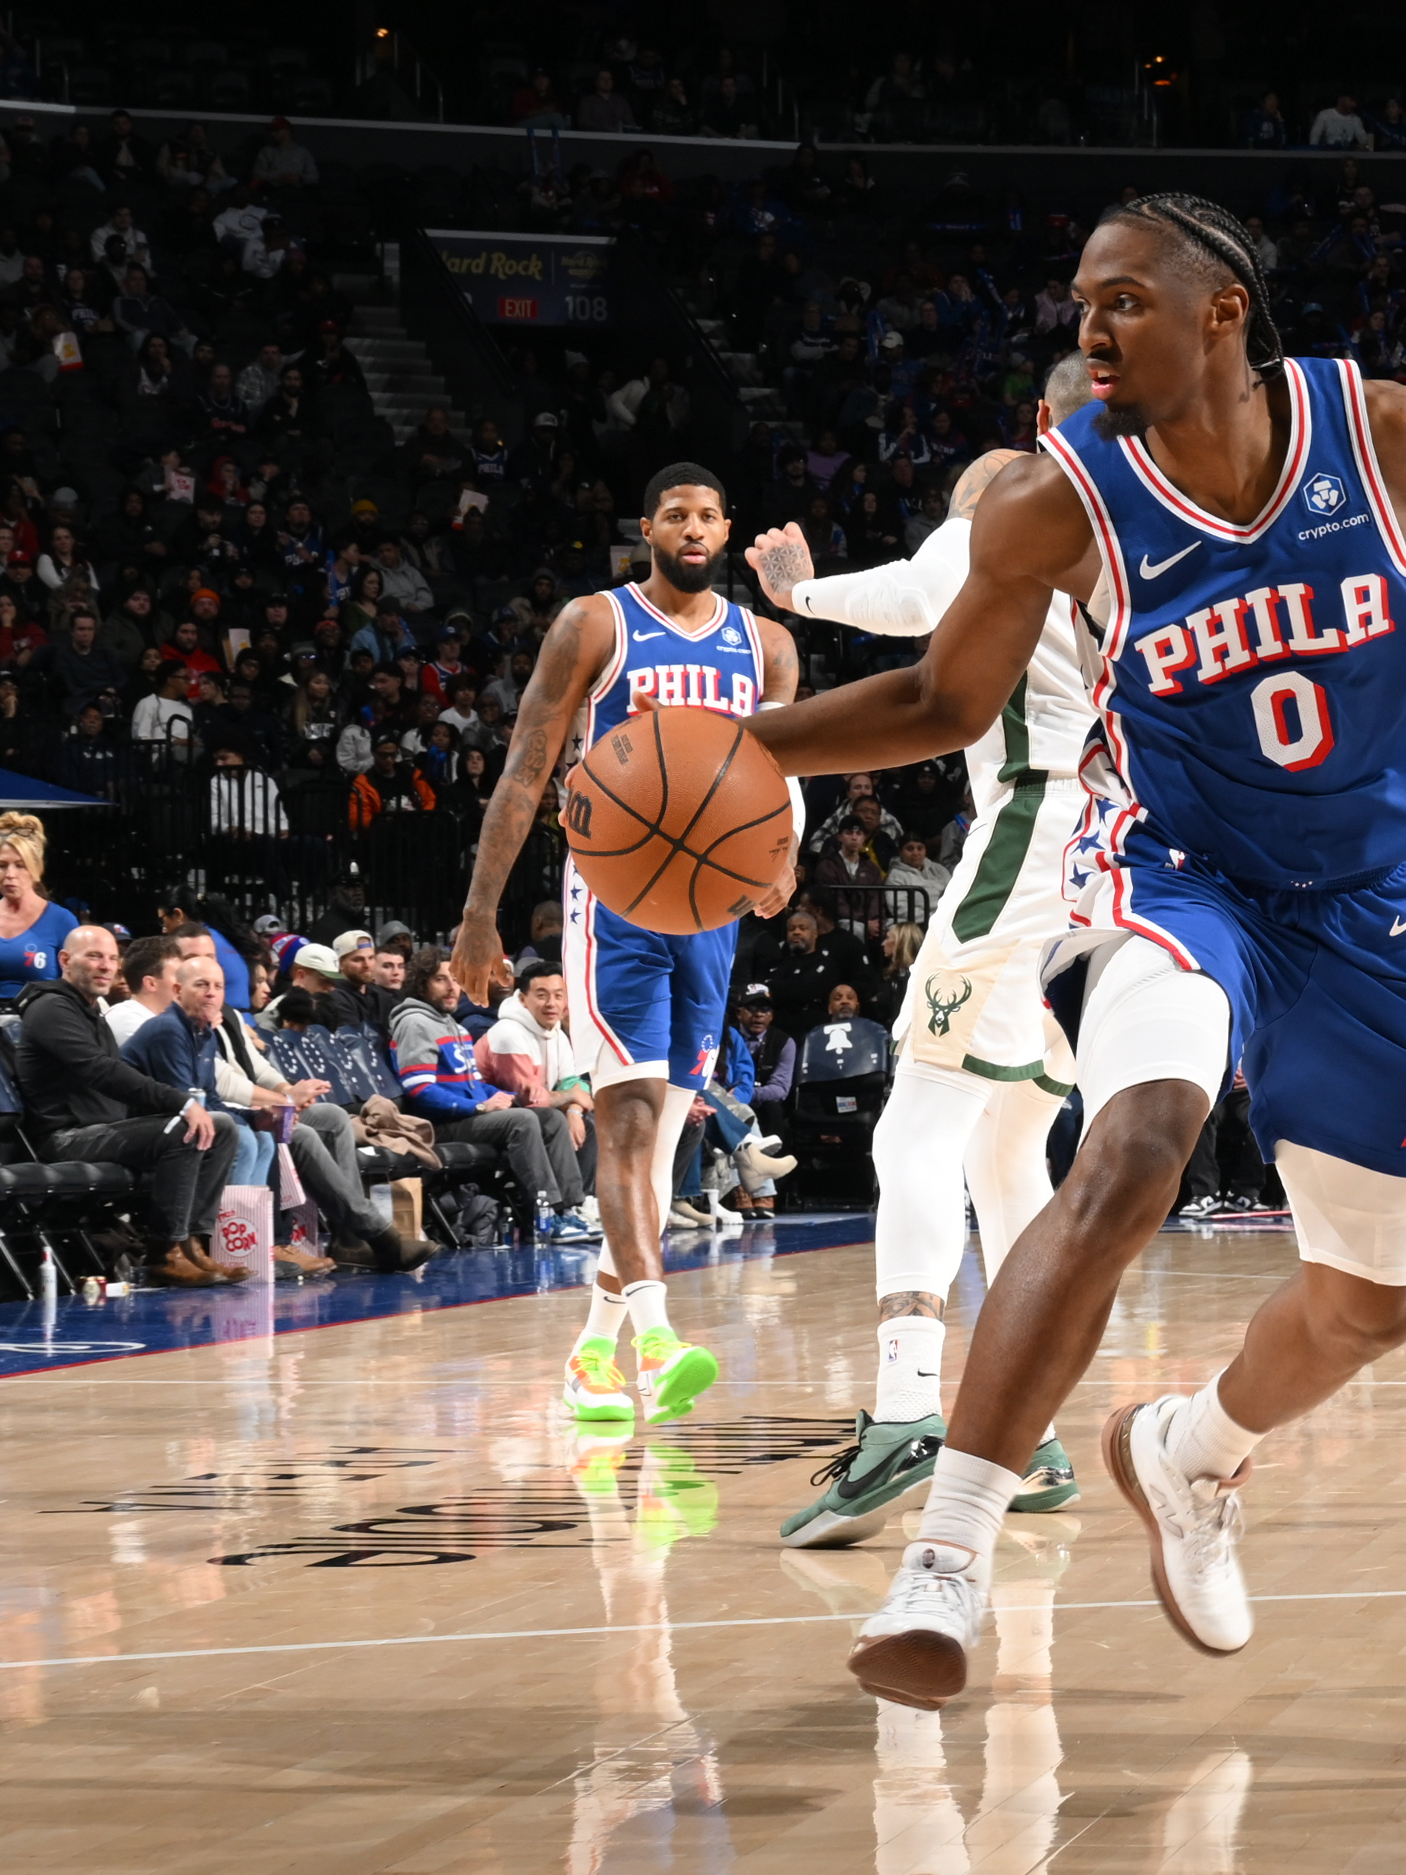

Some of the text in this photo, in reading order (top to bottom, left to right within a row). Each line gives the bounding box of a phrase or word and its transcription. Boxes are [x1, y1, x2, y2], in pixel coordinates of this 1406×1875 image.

[490, 252, 544, 281] Rock
[505, 299, 533, 318] EXIT
[565, 296, 608, 321] 108
[1298, 512, 1370, 541] crypto.com
[1134, 573, 1396, 697] PHILA
[626, 663, 758, 718] PHILA
[1251, 671, 1335, 773] 0
[24, 951, 47, 970] 76
[222, 1221, 247, 1241] POP
[225, 1232, 257, 1253] CORN
